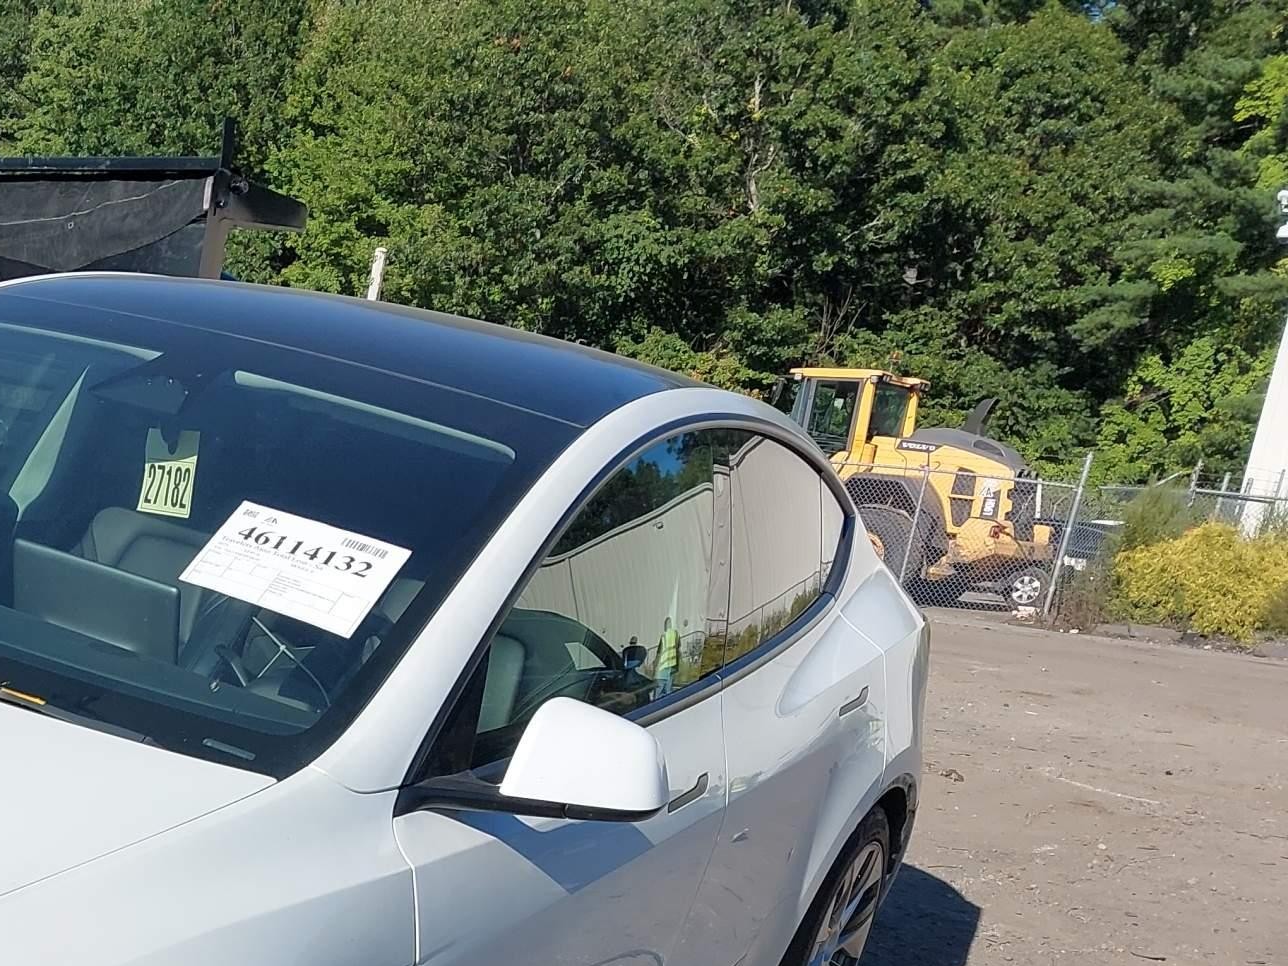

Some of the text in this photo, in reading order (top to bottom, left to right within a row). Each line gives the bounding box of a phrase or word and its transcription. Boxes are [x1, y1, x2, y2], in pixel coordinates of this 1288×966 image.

[902, 442, 936, 451] VOLVO
[144, 464, 191, 509] 27182
[238, 525, 373, 578] 46114132
